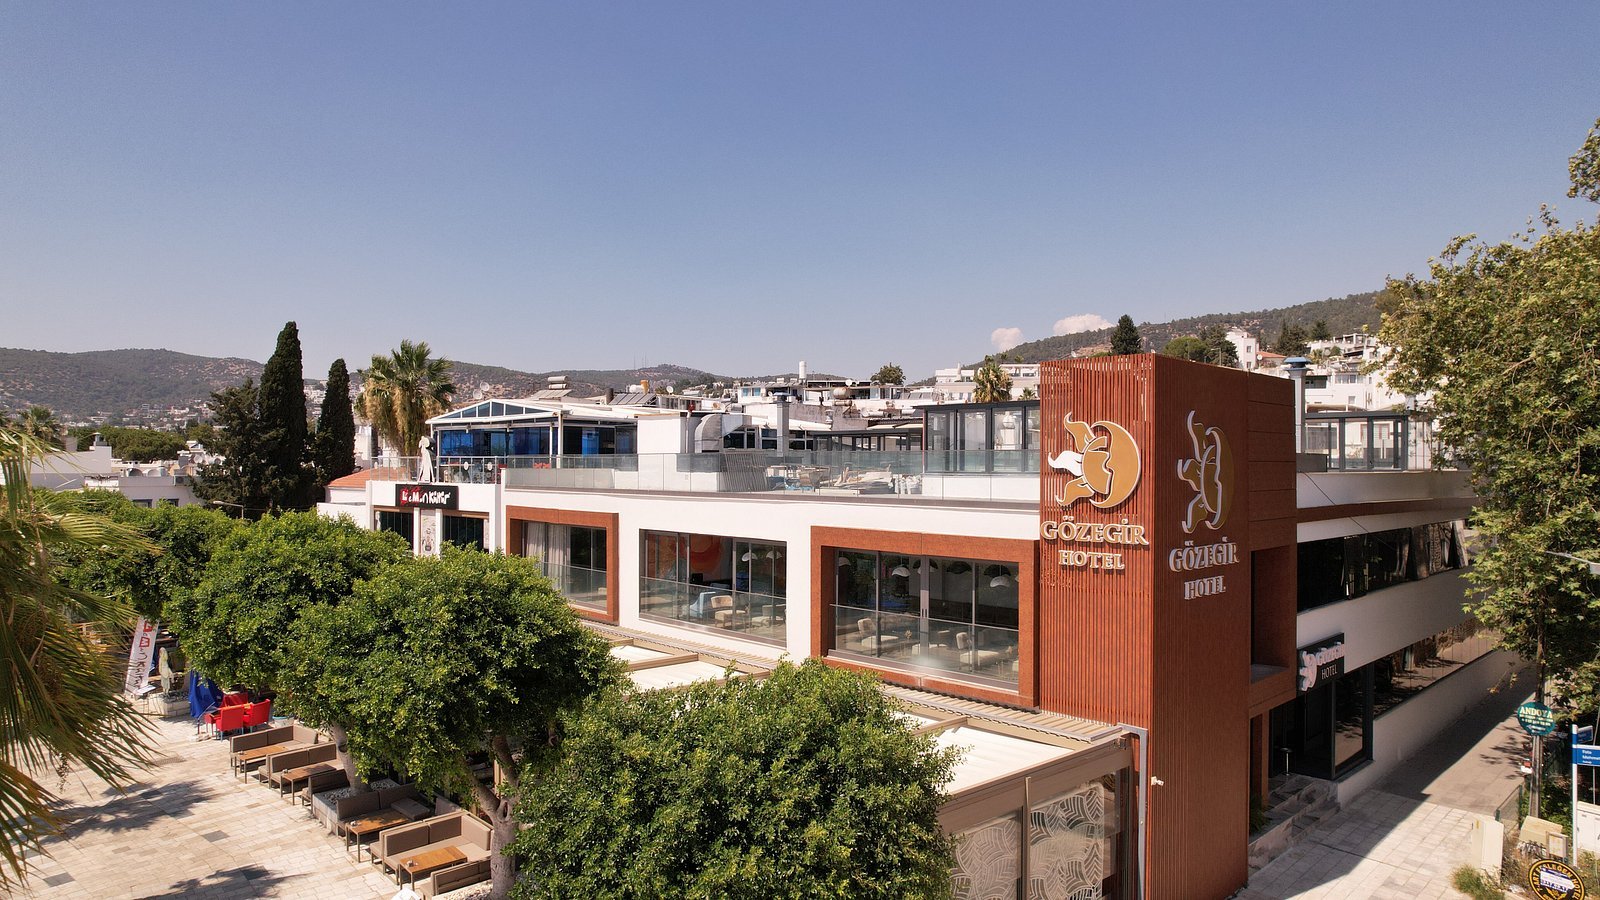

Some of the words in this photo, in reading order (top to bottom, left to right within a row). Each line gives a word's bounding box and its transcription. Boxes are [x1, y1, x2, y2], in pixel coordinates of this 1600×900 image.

[1040, 515, 1149, 545] GÖZEGİR
[1058, 549, 1125, 570] HOTEL
[1184, 575, 1226, 600] HOTEL
[1321, 664, 1338, 680] HOTEL
[1519, 706, 1553, 719] ANDOYA
[1571, 878, 1581, 899] HOTEL
